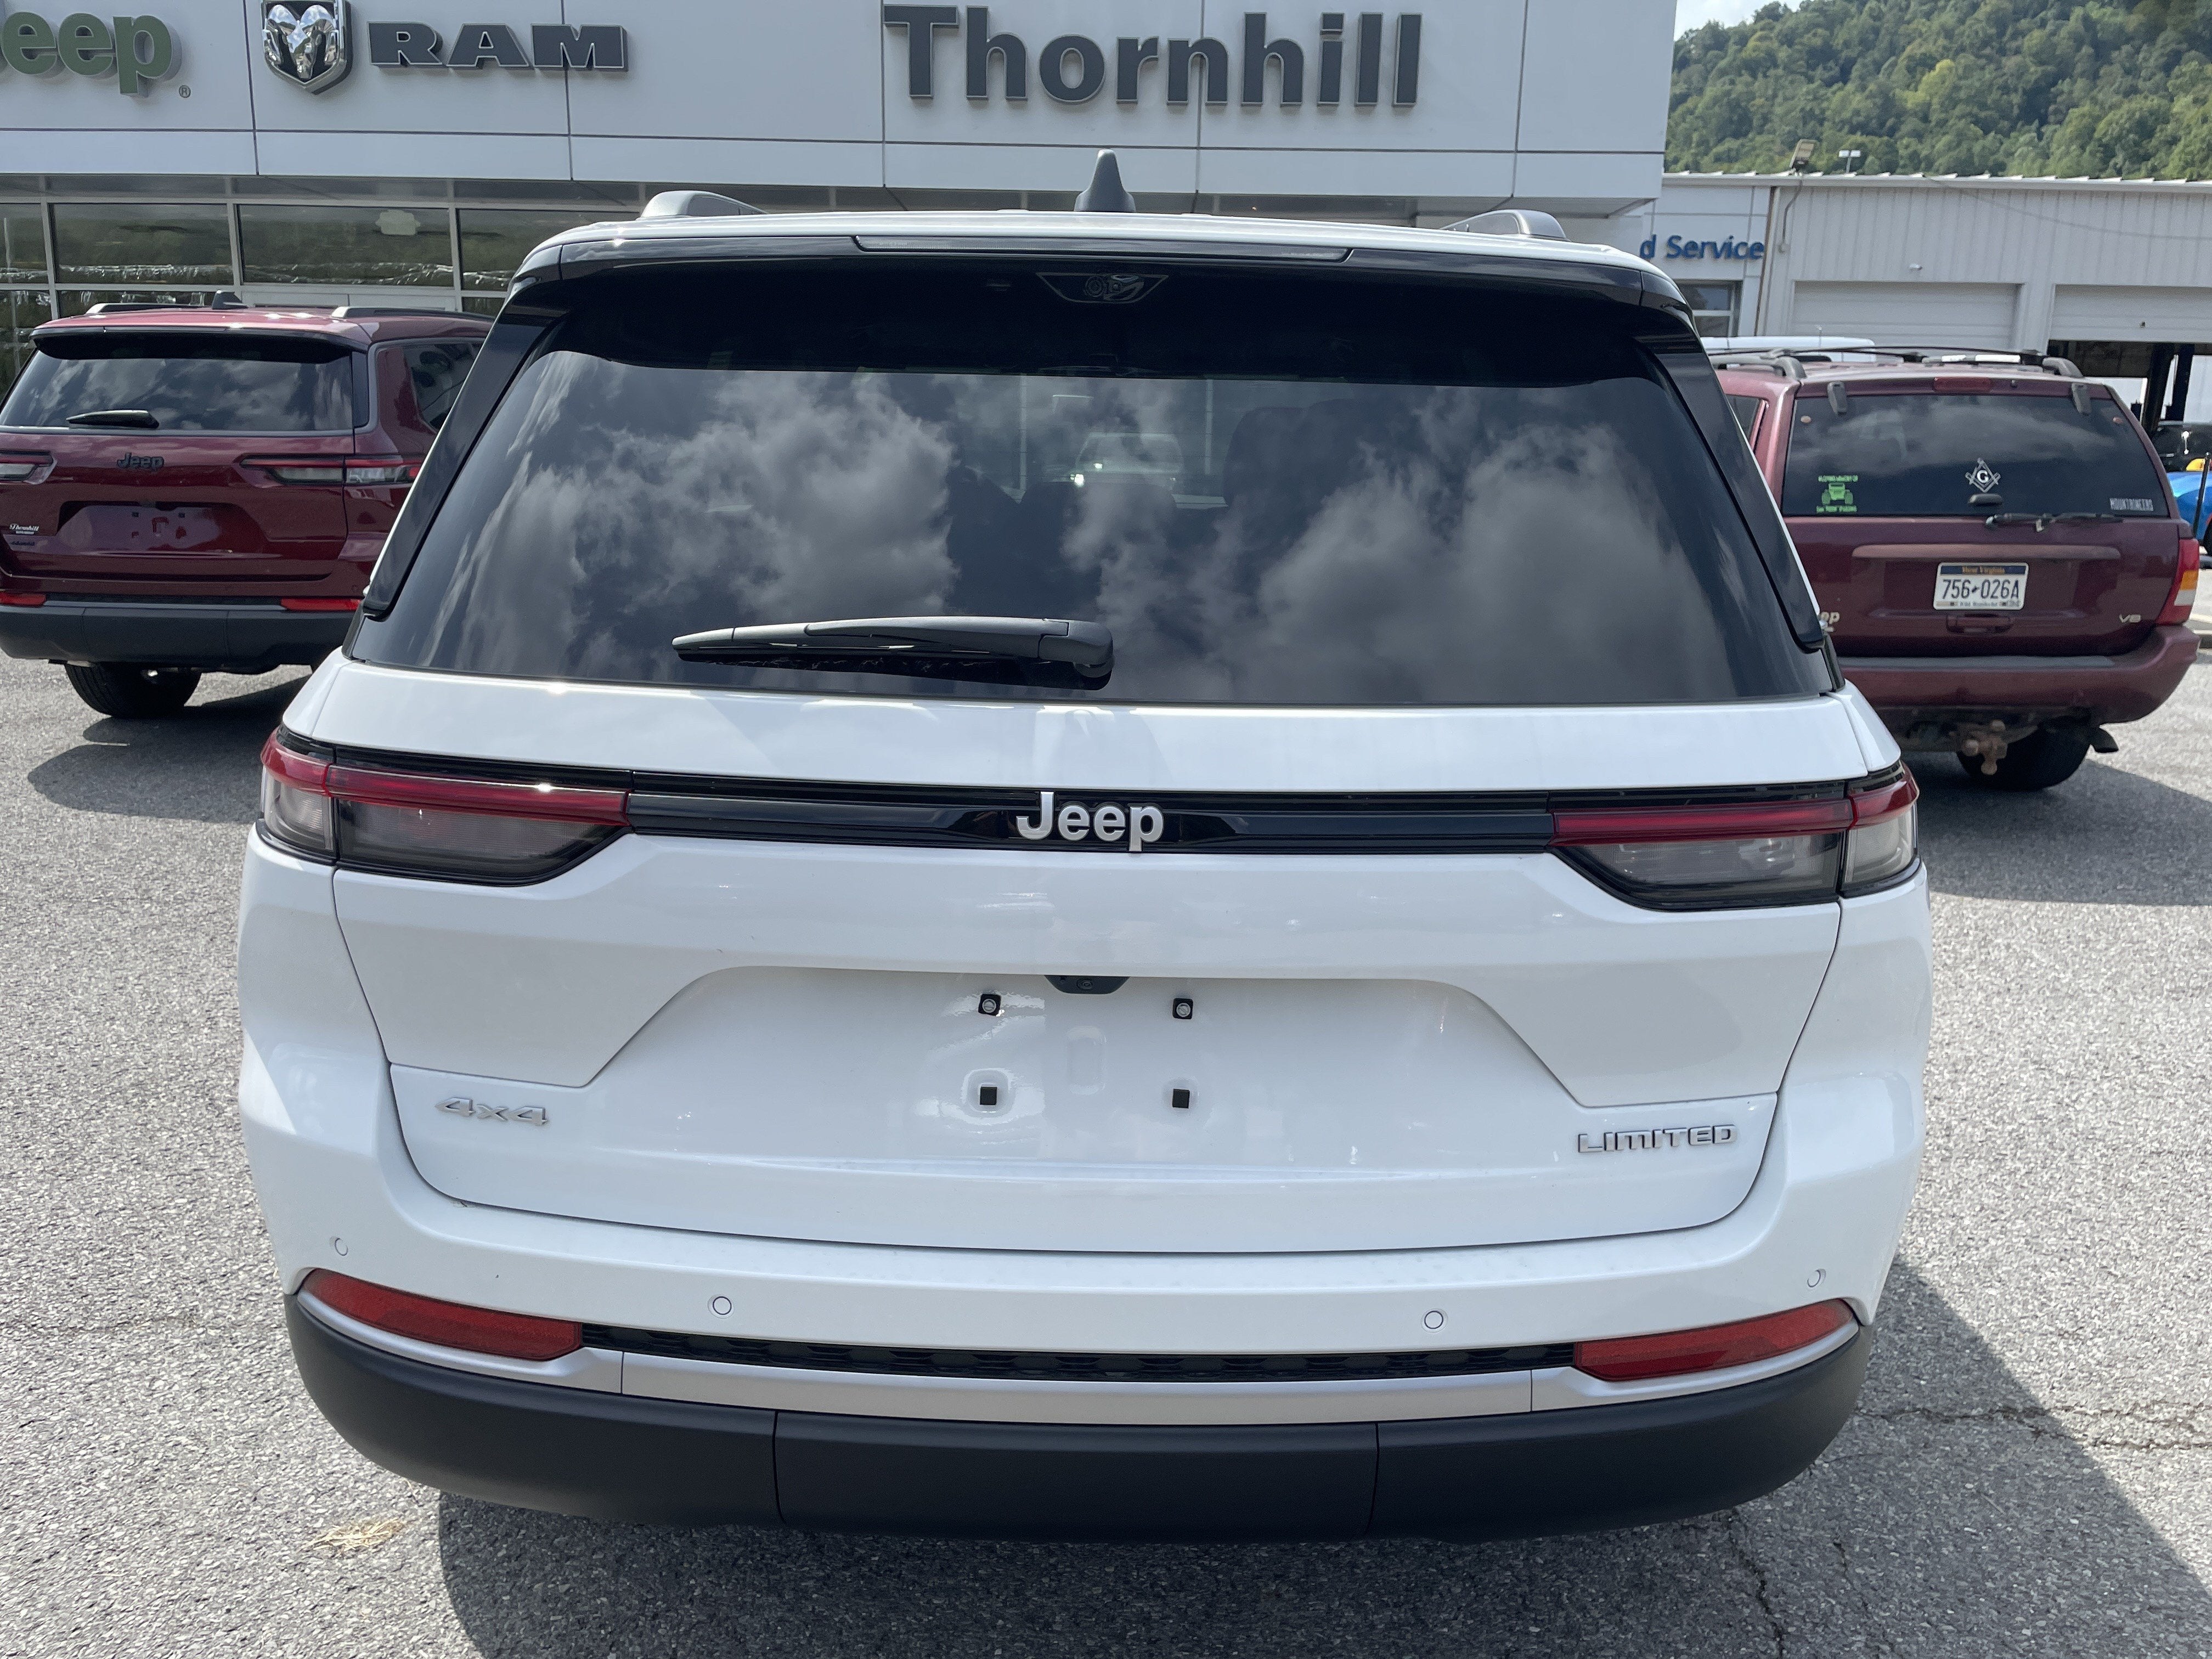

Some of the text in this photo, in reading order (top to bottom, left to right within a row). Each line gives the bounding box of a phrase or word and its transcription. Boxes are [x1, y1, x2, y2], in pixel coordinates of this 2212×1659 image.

[0, 11, 181, 97] eep
[367, 21, 627, 71] RAM
[883, 5, 1422, 107] Thornhill
[1666, 234, 1765, 259] Service
[117, 452, 165, 472] Jeep
[1977, 470, 1989, 483] G
[1015, 791, 1164, 852] Jeep
[435, 1097, 550, 1126] 4x4
[1578, 1124, 1738, 1153] LIMITED
